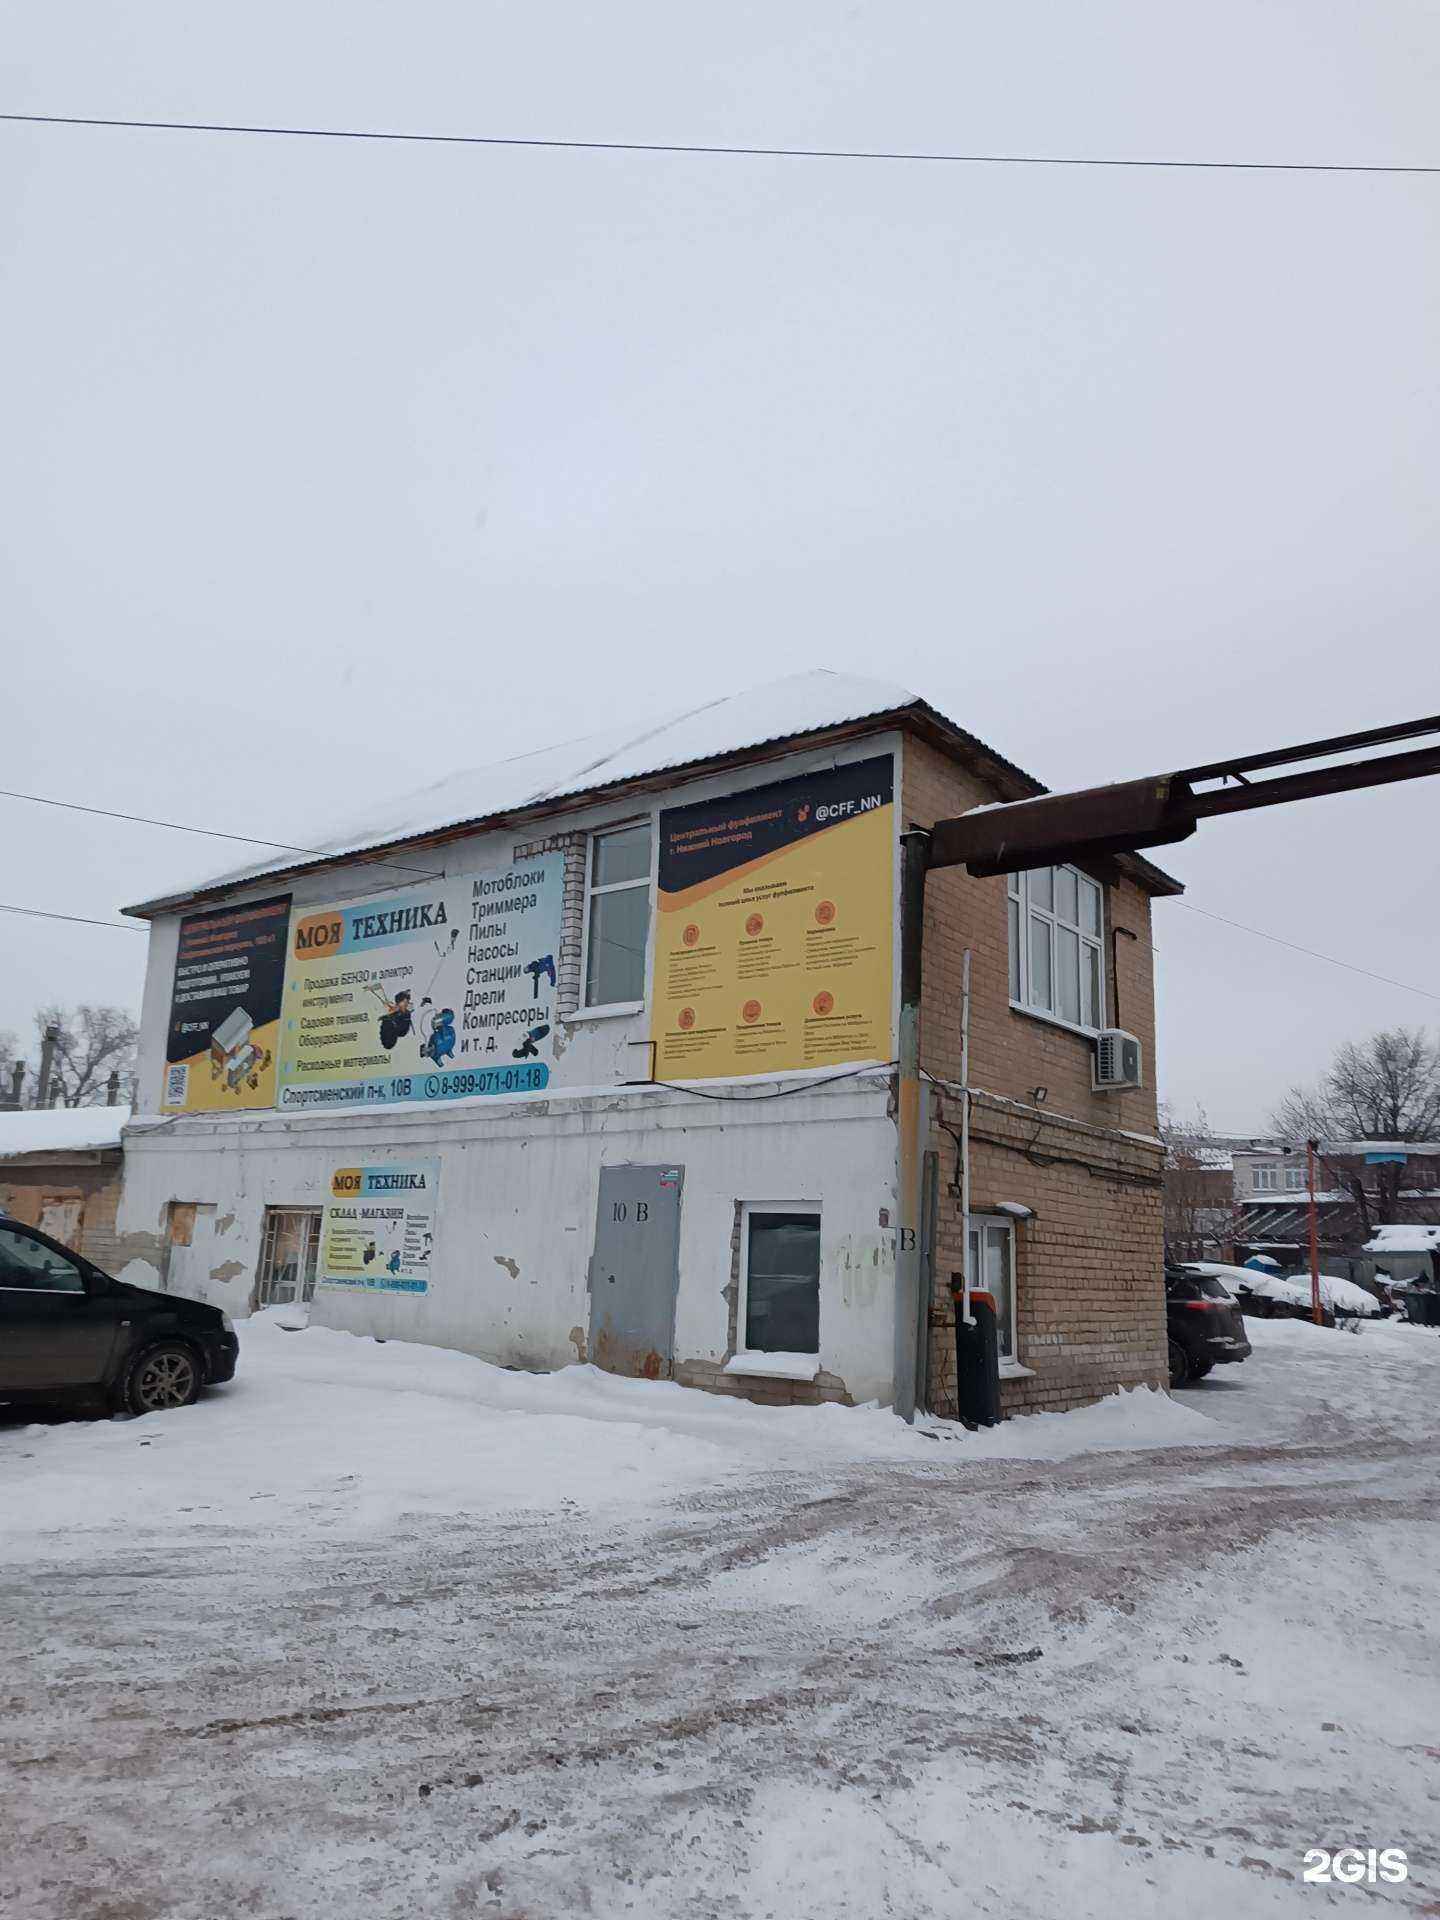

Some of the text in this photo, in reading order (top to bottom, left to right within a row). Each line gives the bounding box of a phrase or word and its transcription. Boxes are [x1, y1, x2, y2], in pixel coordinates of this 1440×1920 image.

[816, 794, 881, 821] @CFF_NN
[472, 870, 545, 898] Мотоблоки
[471, 893, 537, 922] Триммера
[296, 922, 342, 950] МОЯ
[352, 901, 448, 940] ТЕХНИКА
[469, 922, 507, 941] Пилы
[467, 941, 519, 964] Насосы
[340, 969, 370, 985] БЕНЗО
[379, 965, 414, 980] электро
[466, 964, 521, 985] Станции
[463, 989, 505, 1011] Дрели
[462, 1006, 549, 1030] Компресоры
[461, 1036, 498, 1054] и т. д.
[282, 1083, 365, 1107] Спортсменский
[390, 1078, 411, 1097] 10В
[441, 1068, 541, 1095] 8-999-071-01-18
[332, 1173, 426, 1190] МОЯ ТЕХНИКА
[613, 1202, 648, 1222] 10 В
